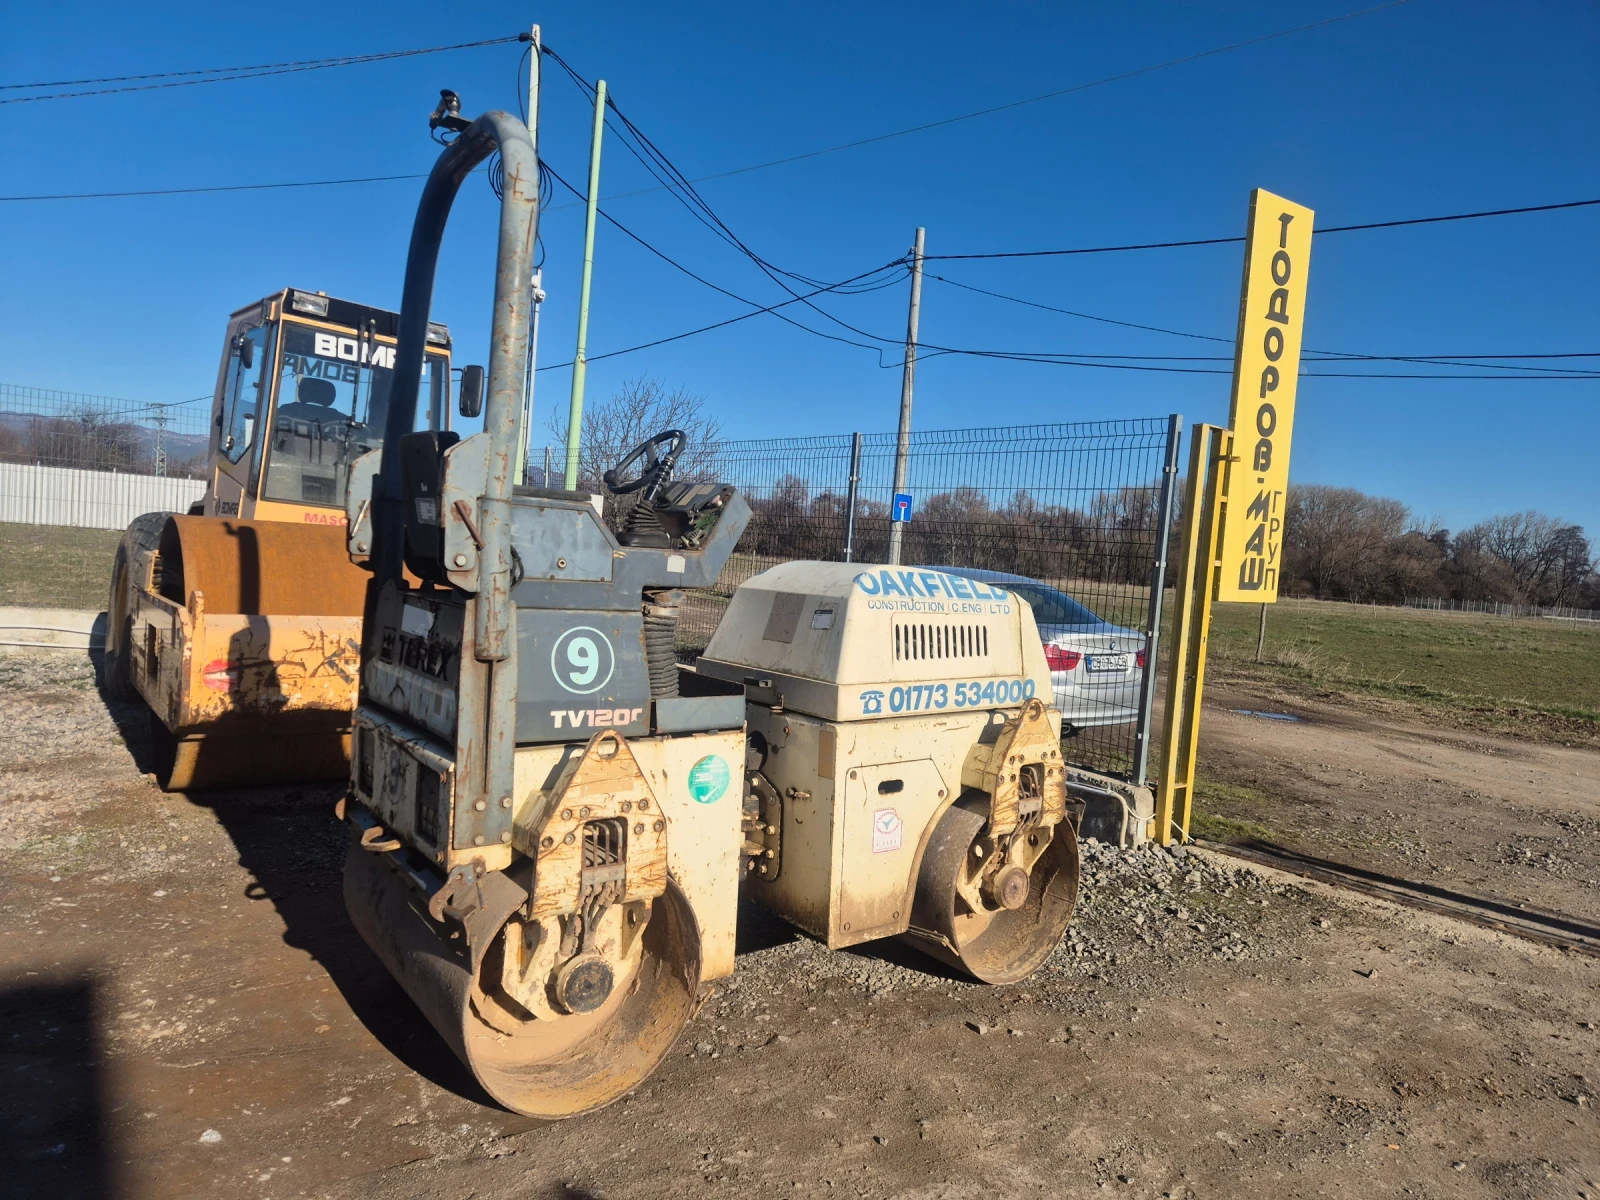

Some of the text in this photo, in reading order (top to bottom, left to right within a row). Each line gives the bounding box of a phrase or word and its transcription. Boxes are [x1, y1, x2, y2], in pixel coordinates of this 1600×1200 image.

[1263, 491, 1283, 591] ГРУП
[867, 599, 944, 612] CONSTRUCTION
[989, 603, 1010, 615] LTD
[566, 637, 599, 685] 9
[889, 679, 1035, 713] 01773 534000
